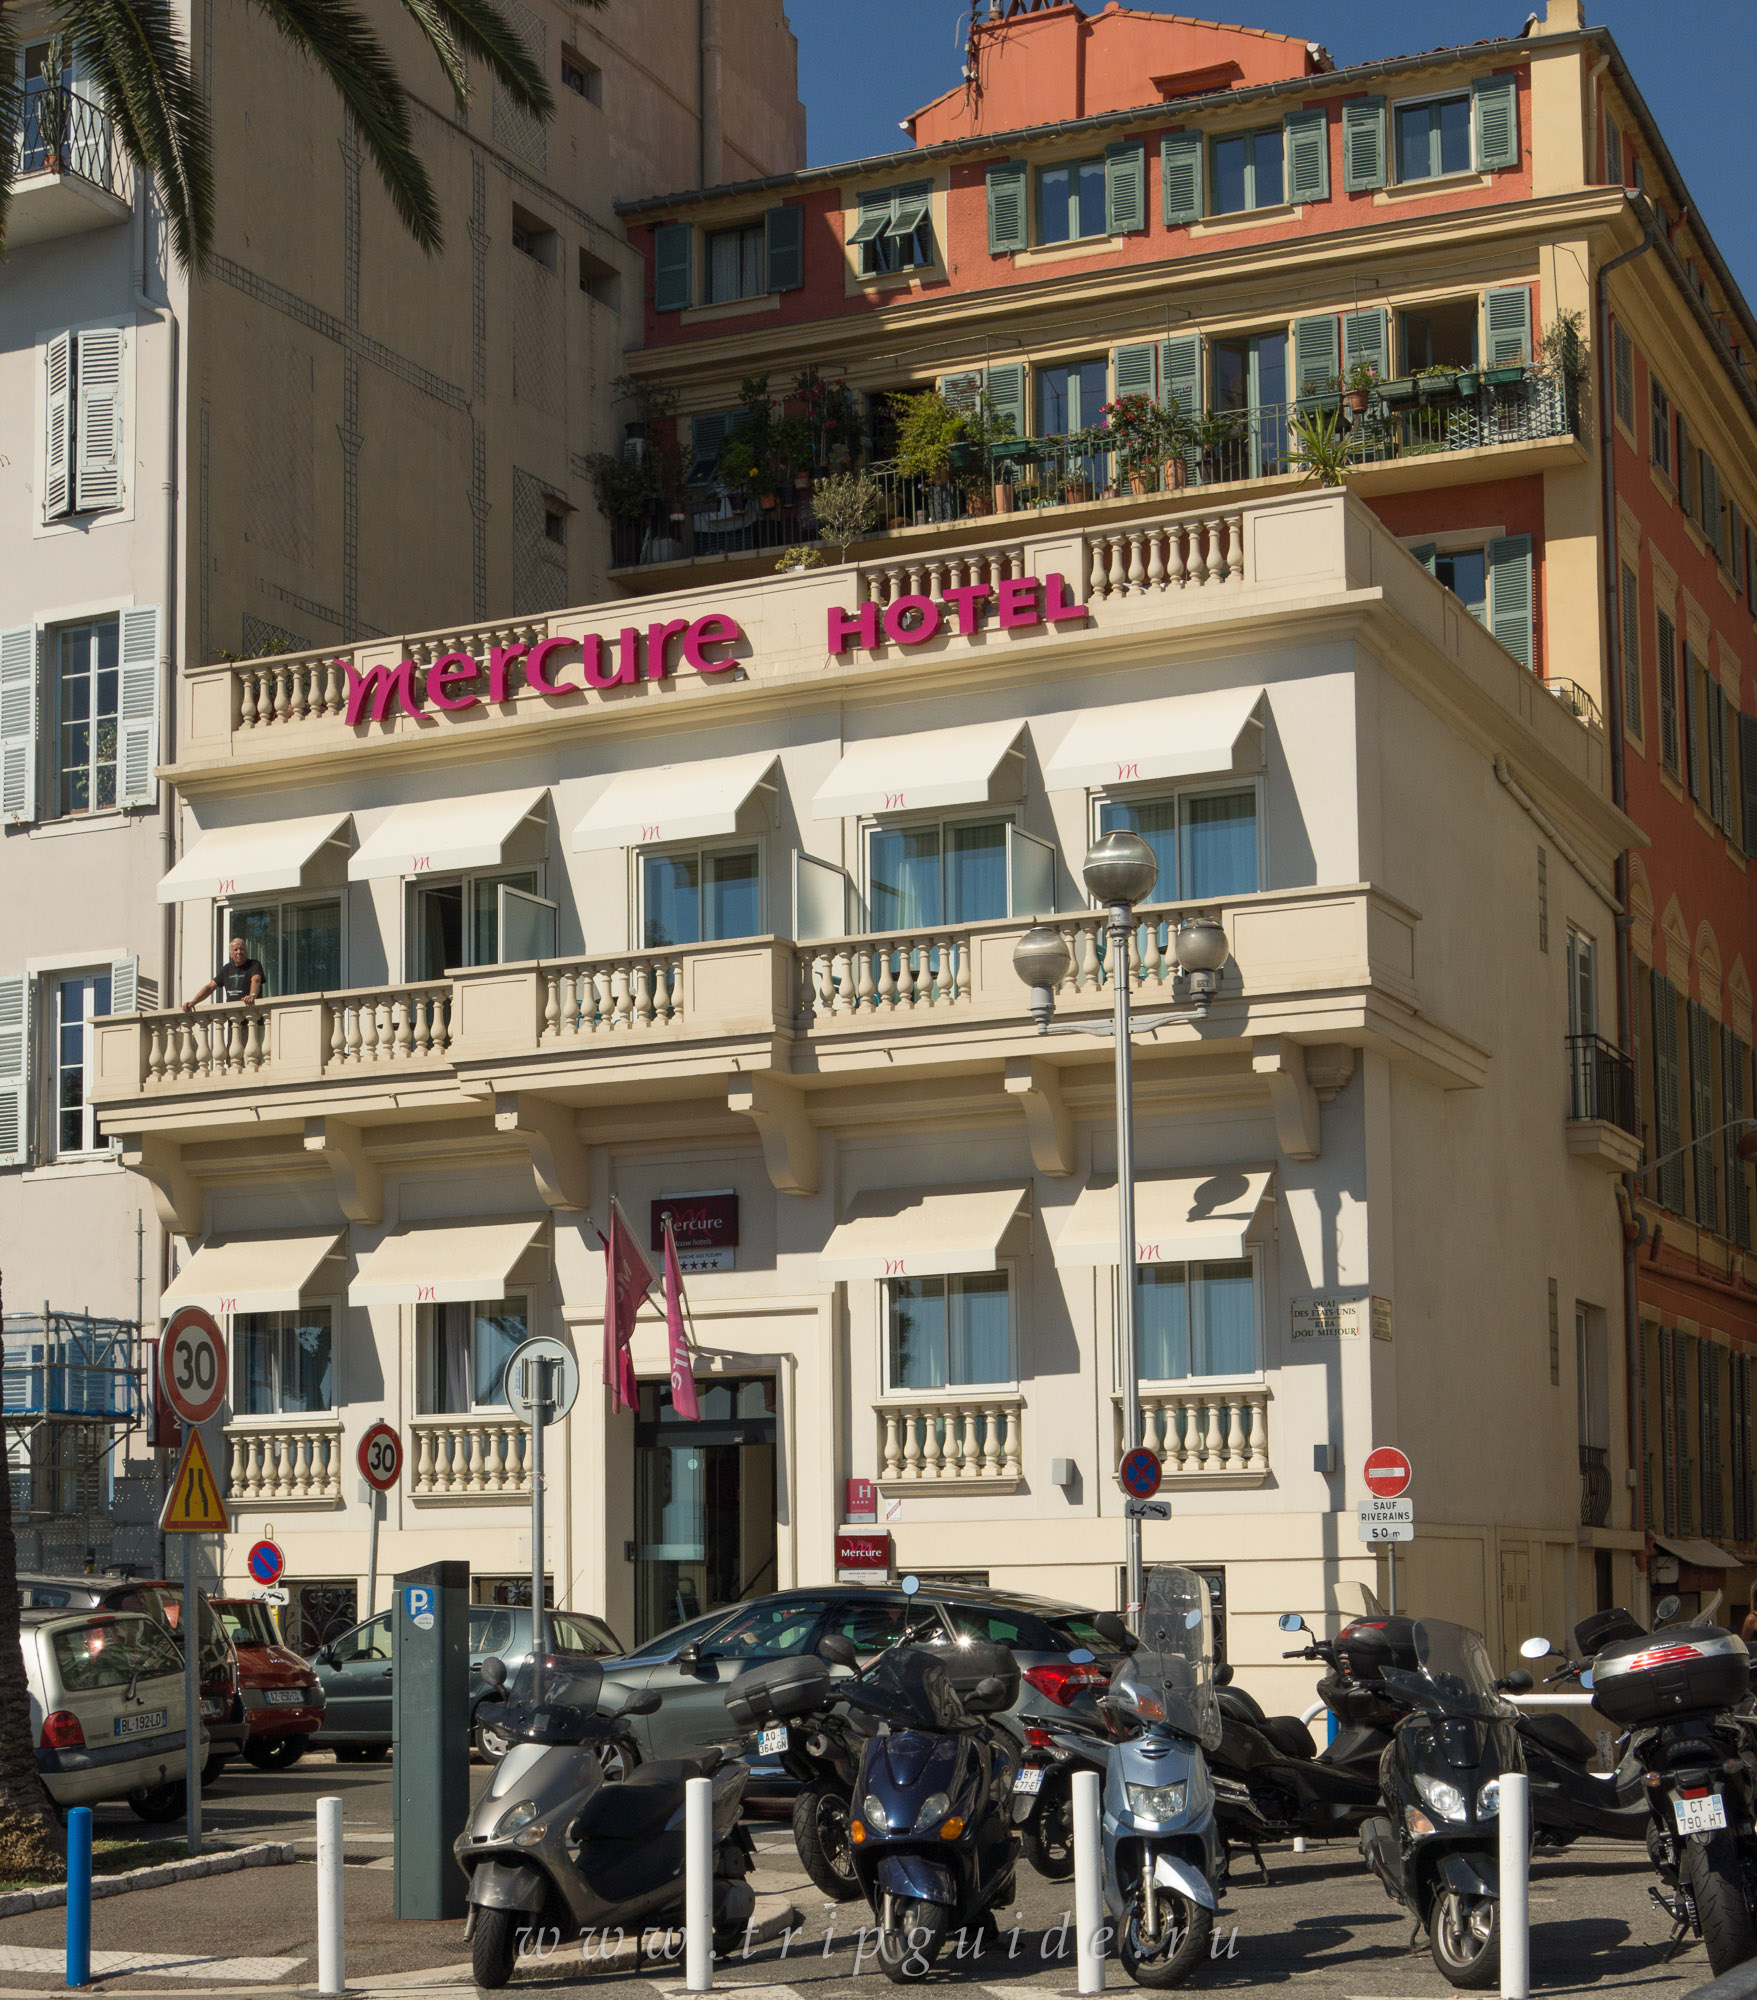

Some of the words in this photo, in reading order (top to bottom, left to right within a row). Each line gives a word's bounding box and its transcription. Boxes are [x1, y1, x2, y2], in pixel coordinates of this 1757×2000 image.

[827, 572, 1090, 655] HOTEL
[1313, 1300, 1336, 1309] QUAI
[1294, 1310, 1309, 1318] DES
[1315, 1320, 1335, 1328] RIBA
[1318, 1327, 1357, 1337] MIEJOUR
[176, 1340, 216, 1391] 30
[370, 1441, 396, 1473] 30
[858, 1485, 872, 1498] H
[1373, 1501, 1398, 1510] SAUF
[1361, 1511, 1410, 1521] RIVERAINS
[1371, 1527, 1388, 1538] 50
[841, 1548, 882, 1557] Mercure
[410, 1589, 428, 1615] P
